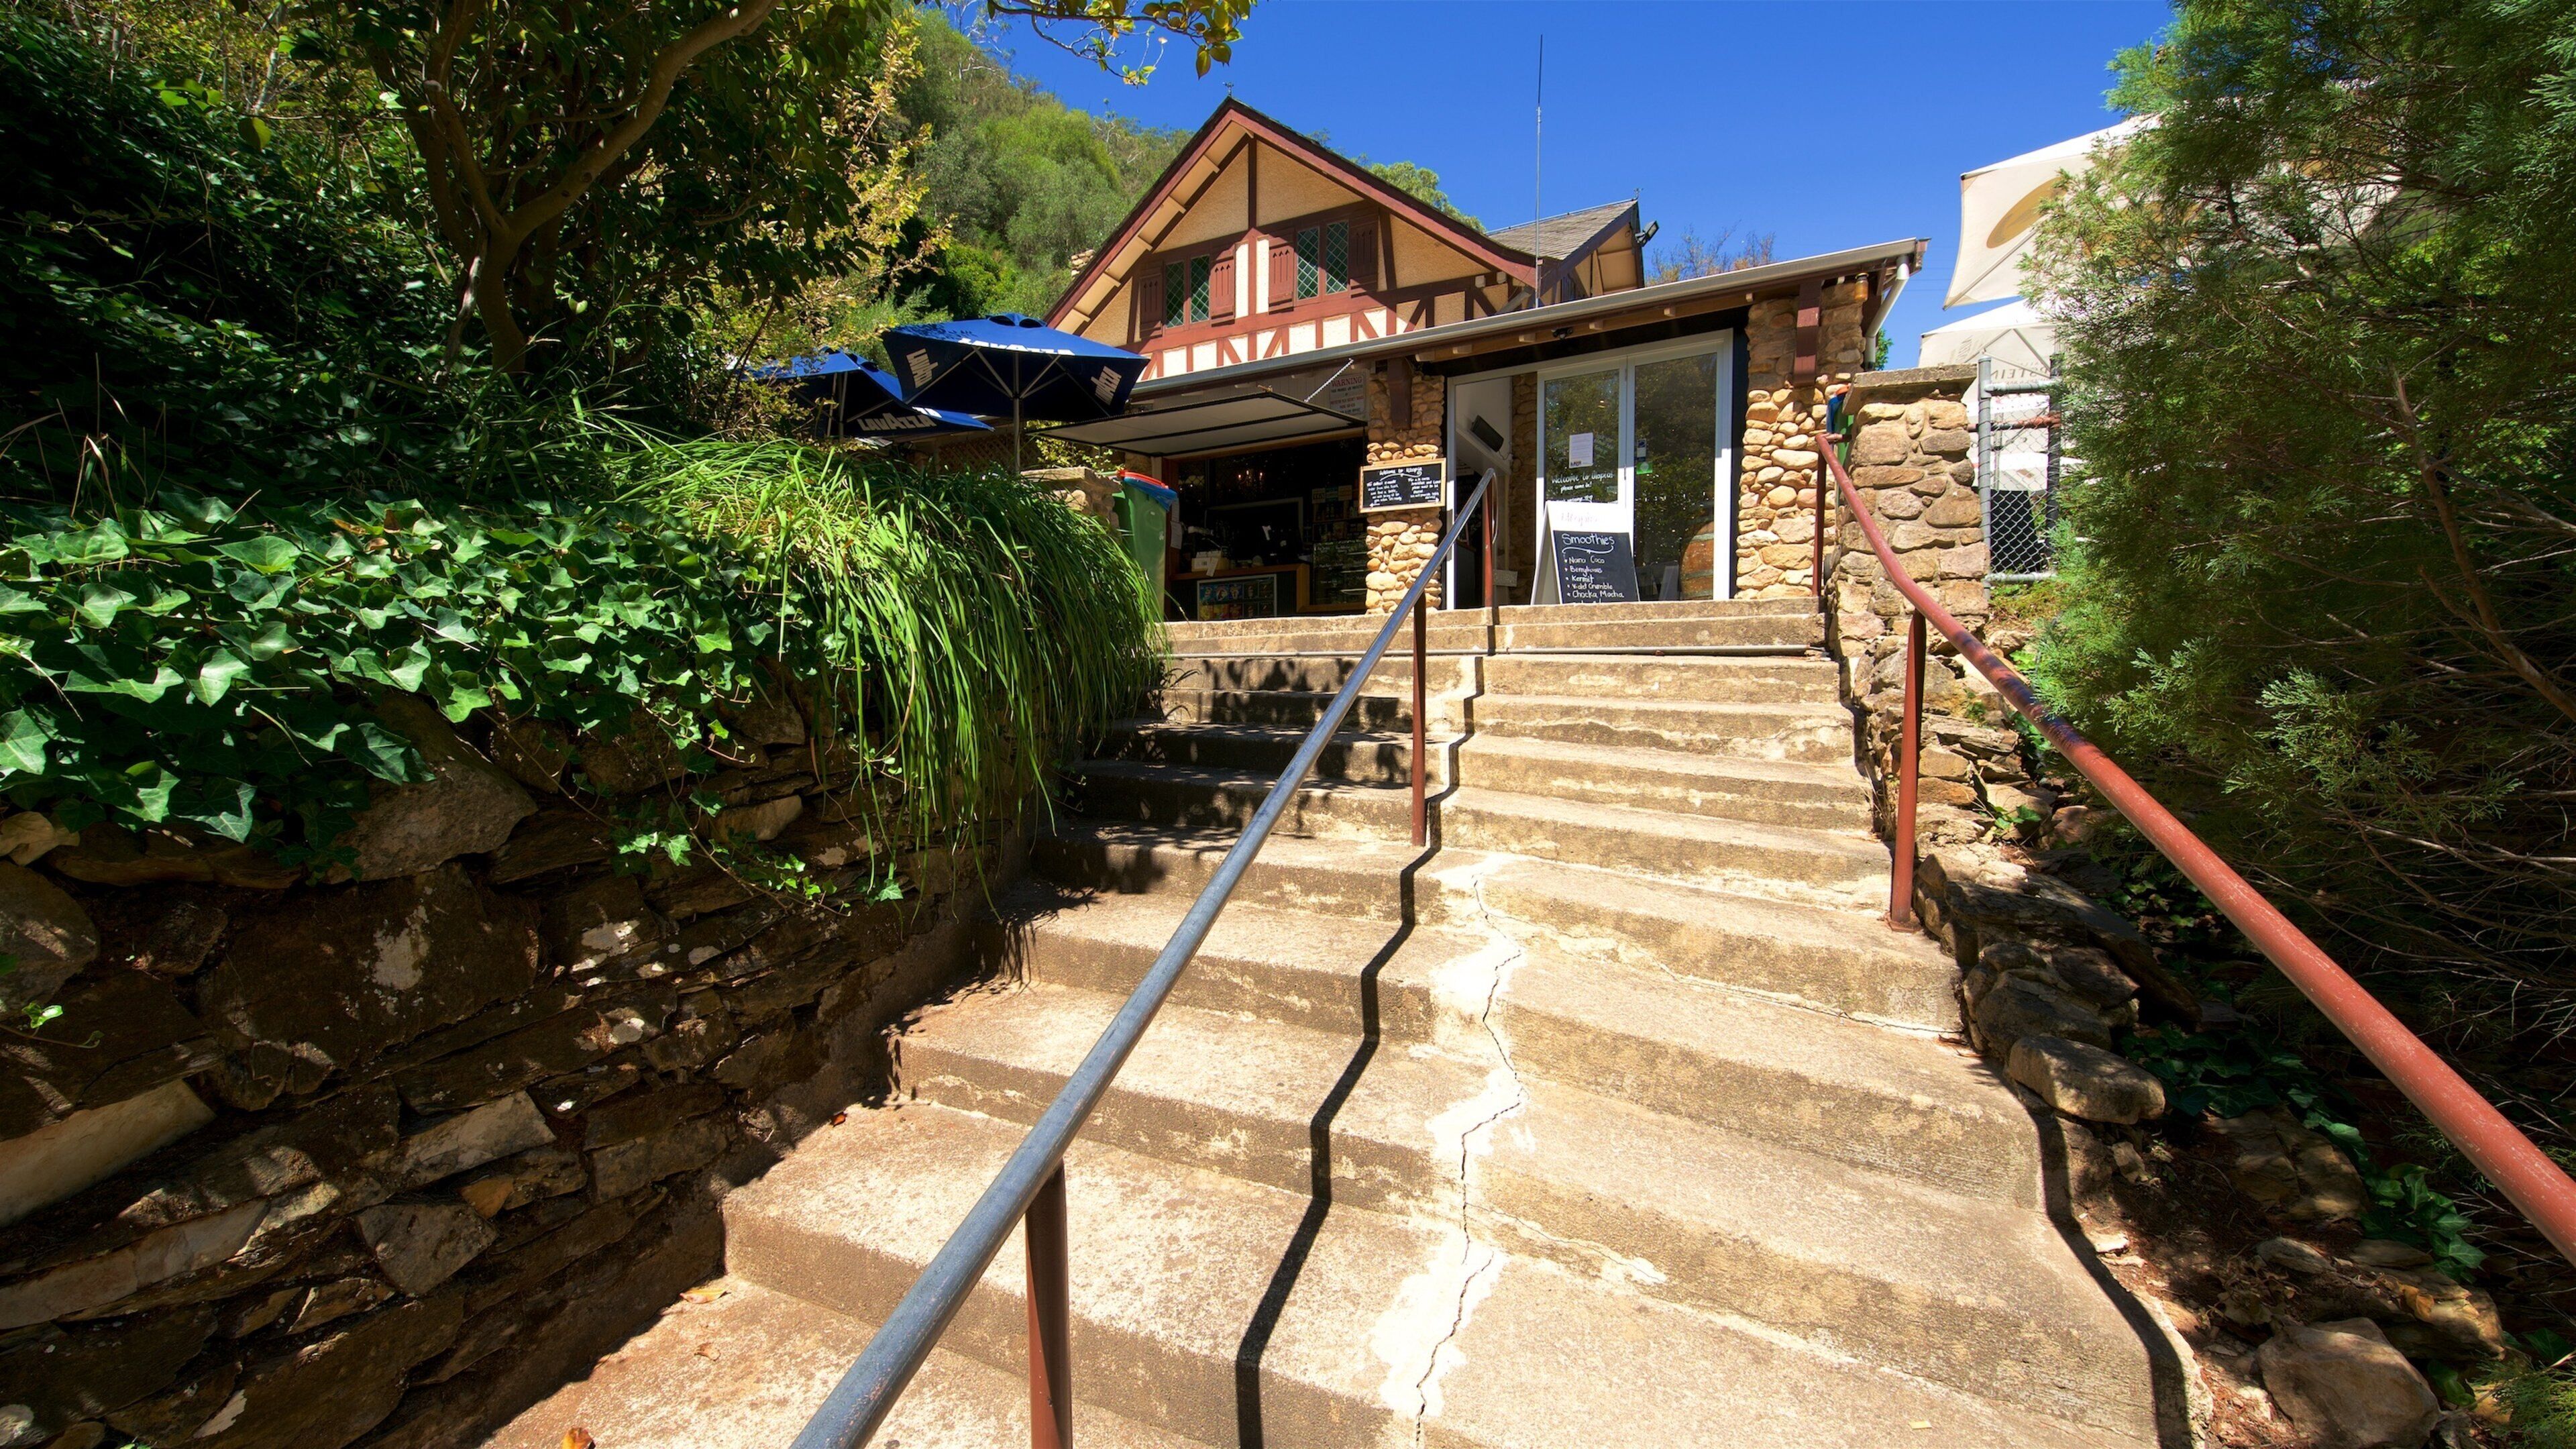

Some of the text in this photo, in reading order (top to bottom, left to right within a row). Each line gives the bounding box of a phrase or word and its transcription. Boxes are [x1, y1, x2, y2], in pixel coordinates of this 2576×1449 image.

[1330, 376, 1363, 387] WARNING
[857, 413, 937, 431] LAVAZZA
[1552, 474, 1579, 484] Welcome
[1562, 533, 1615, 545] Smoothies
[1590, 555, 1605, 564] Coco
[1572, 574, 1594, 583] Kermit
[1572, 590, 1598, 598] Chocka
